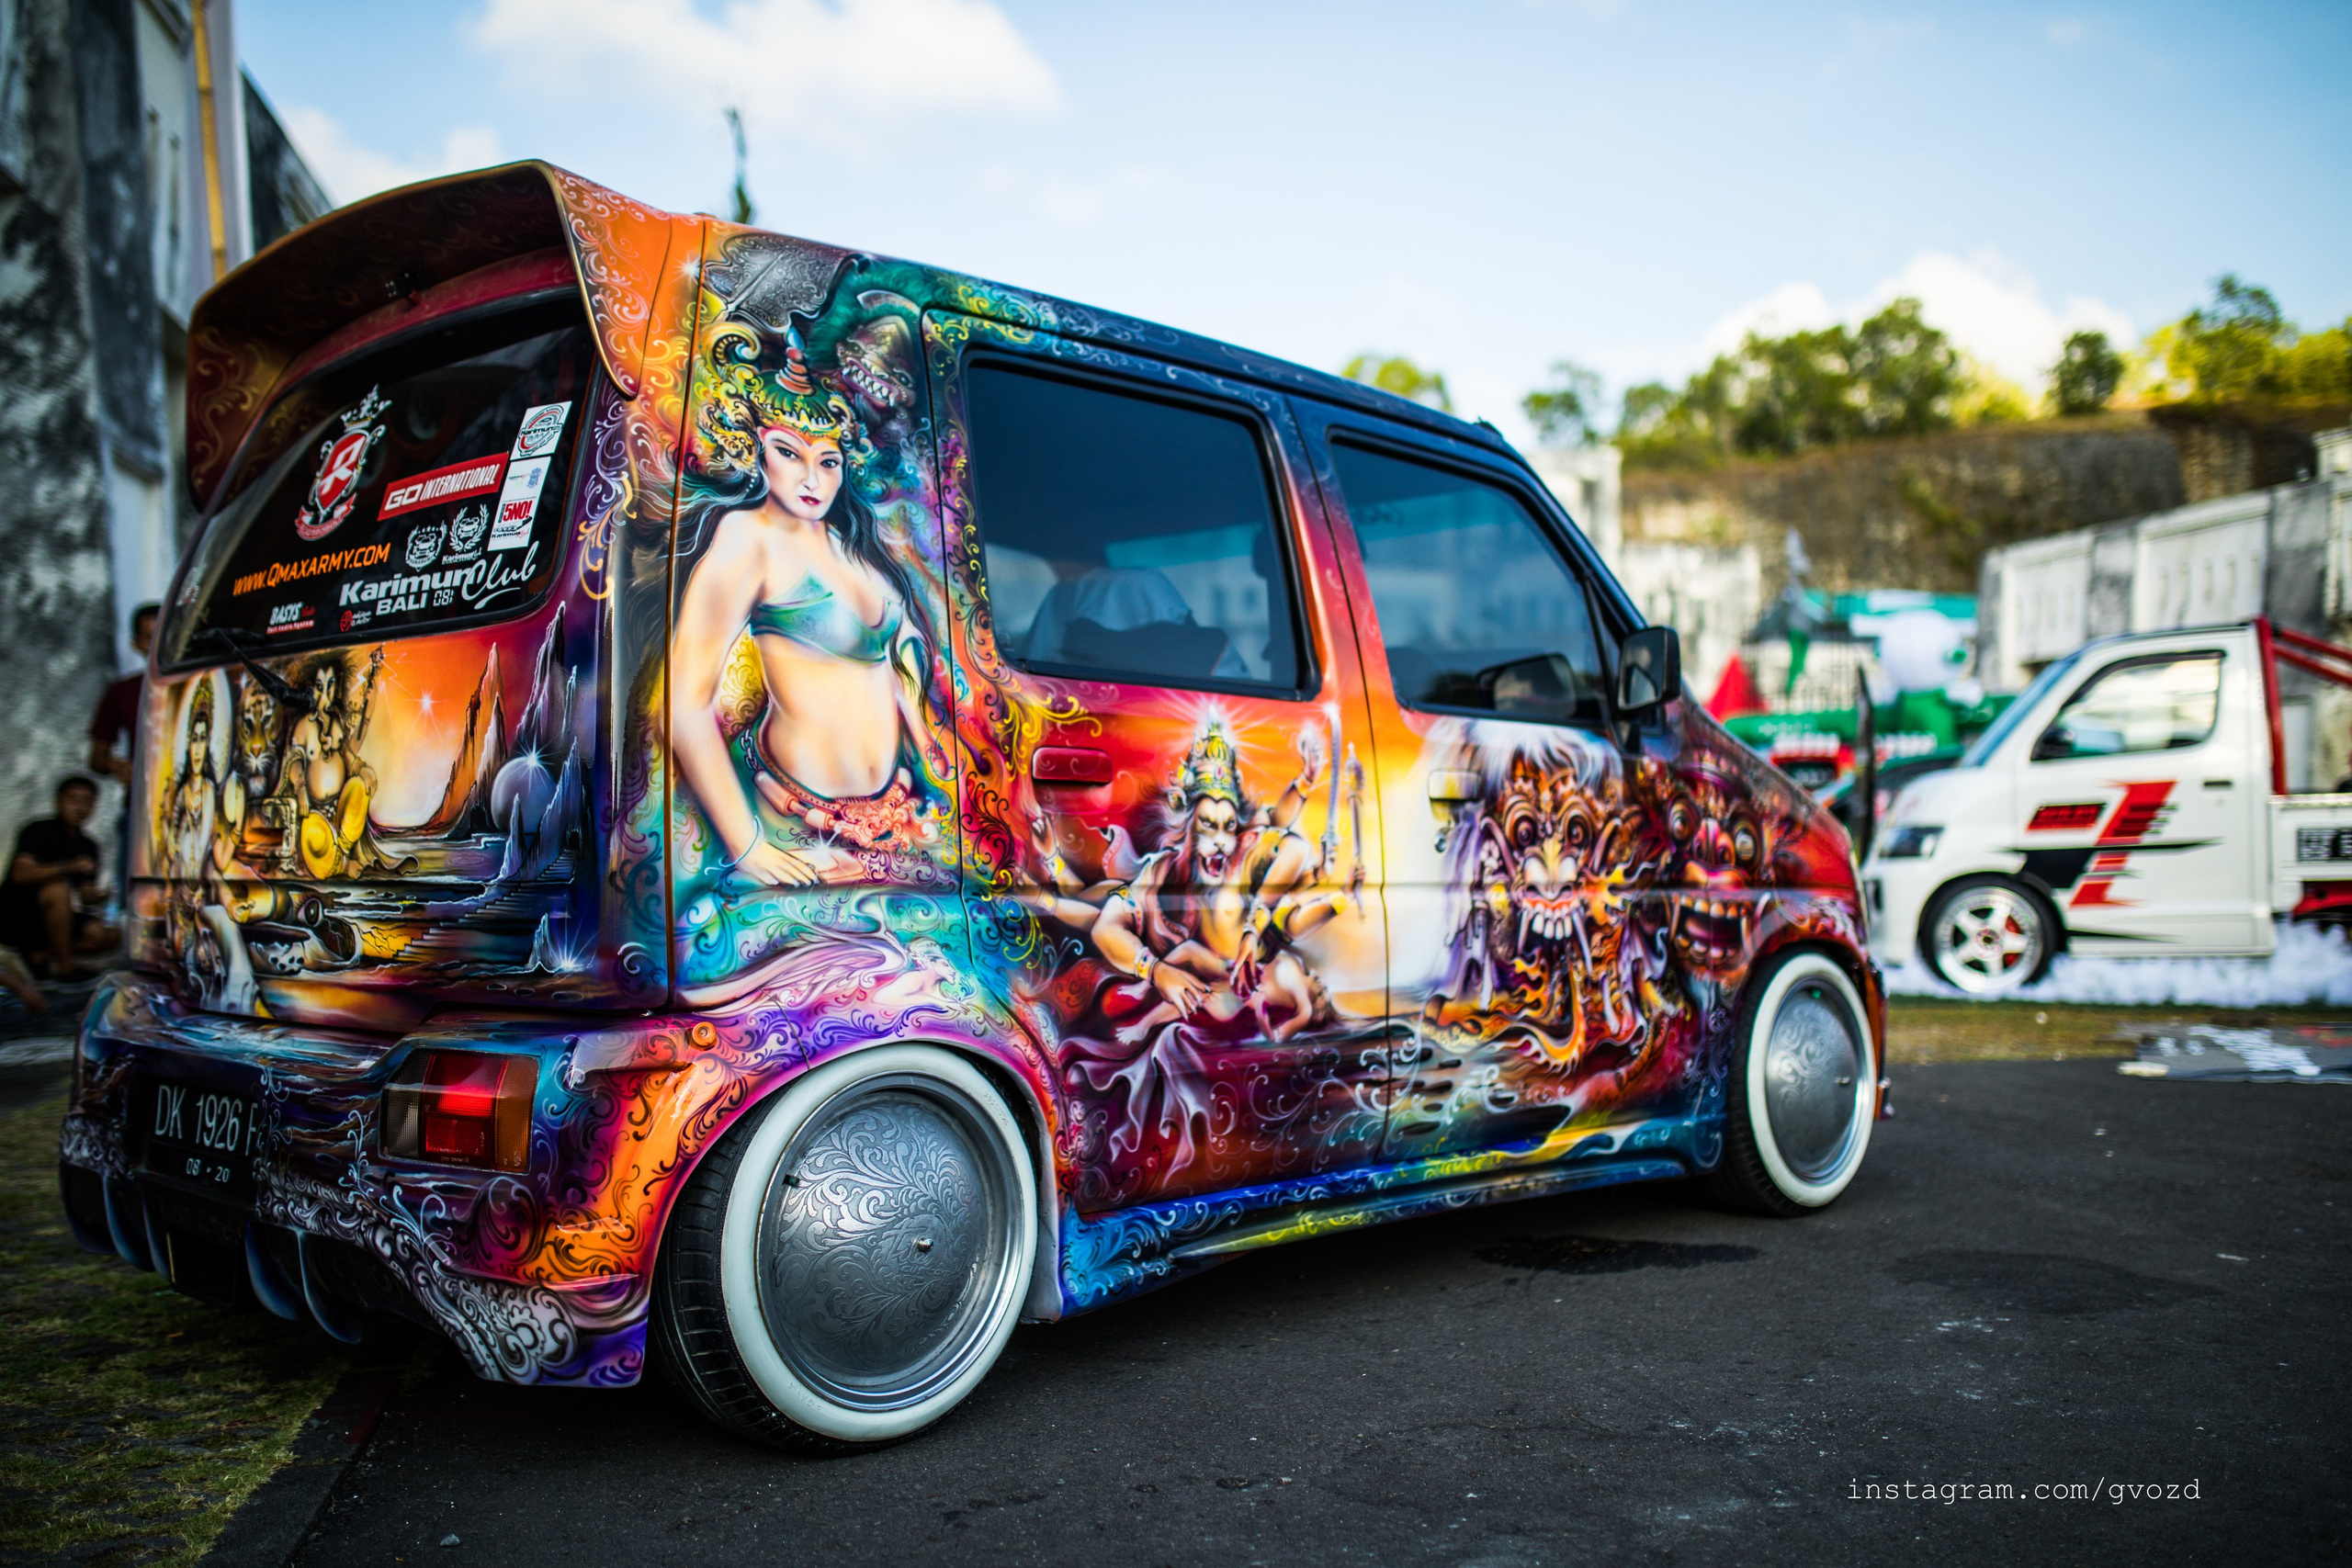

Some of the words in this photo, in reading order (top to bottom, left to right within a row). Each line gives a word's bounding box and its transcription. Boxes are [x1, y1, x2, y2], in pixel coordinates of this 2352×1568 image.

[384, 482, 424, 511] GO
[420, 463, 500, 502] INTERNATIONAL
[339, 567, 477, 606] Karimun
[461, 540, 539, 609] Club
[376, 592, 427, 615] BALI
[154, 1084, 187, 1139] DK
[195, 1093, 243, 1152] 1926
[186, 1157, 201, 1176] 08
[214, 1166, 231, 1183] 20
